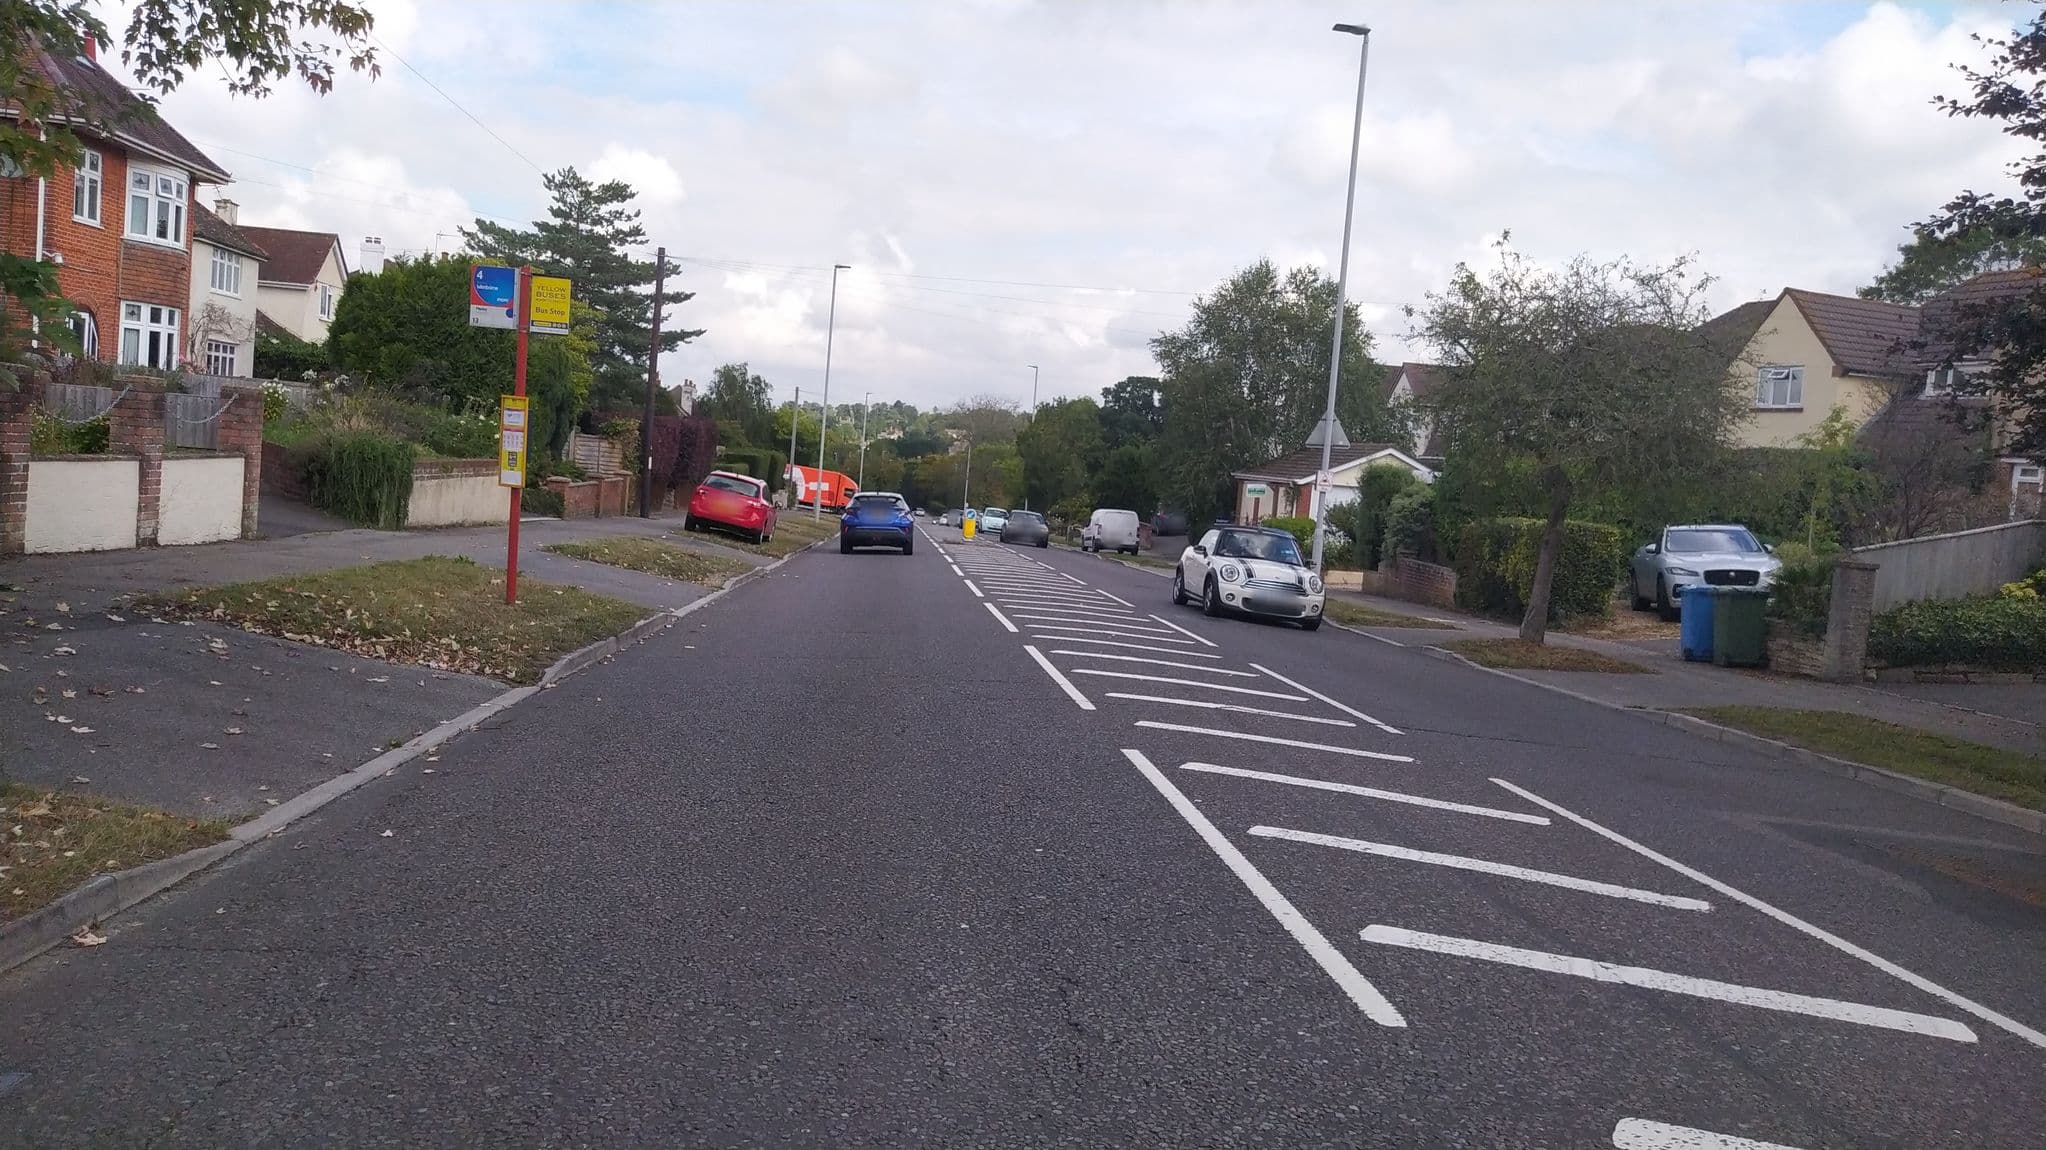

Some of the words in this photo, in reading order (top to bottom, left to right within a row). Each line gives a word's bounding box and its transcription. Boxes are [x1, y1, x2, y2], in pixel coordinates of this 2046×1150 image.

[476, 270, 482, 280] 4
[536, 291, 566, 300] BUSES
[550, 308, 566, 316] Stop
